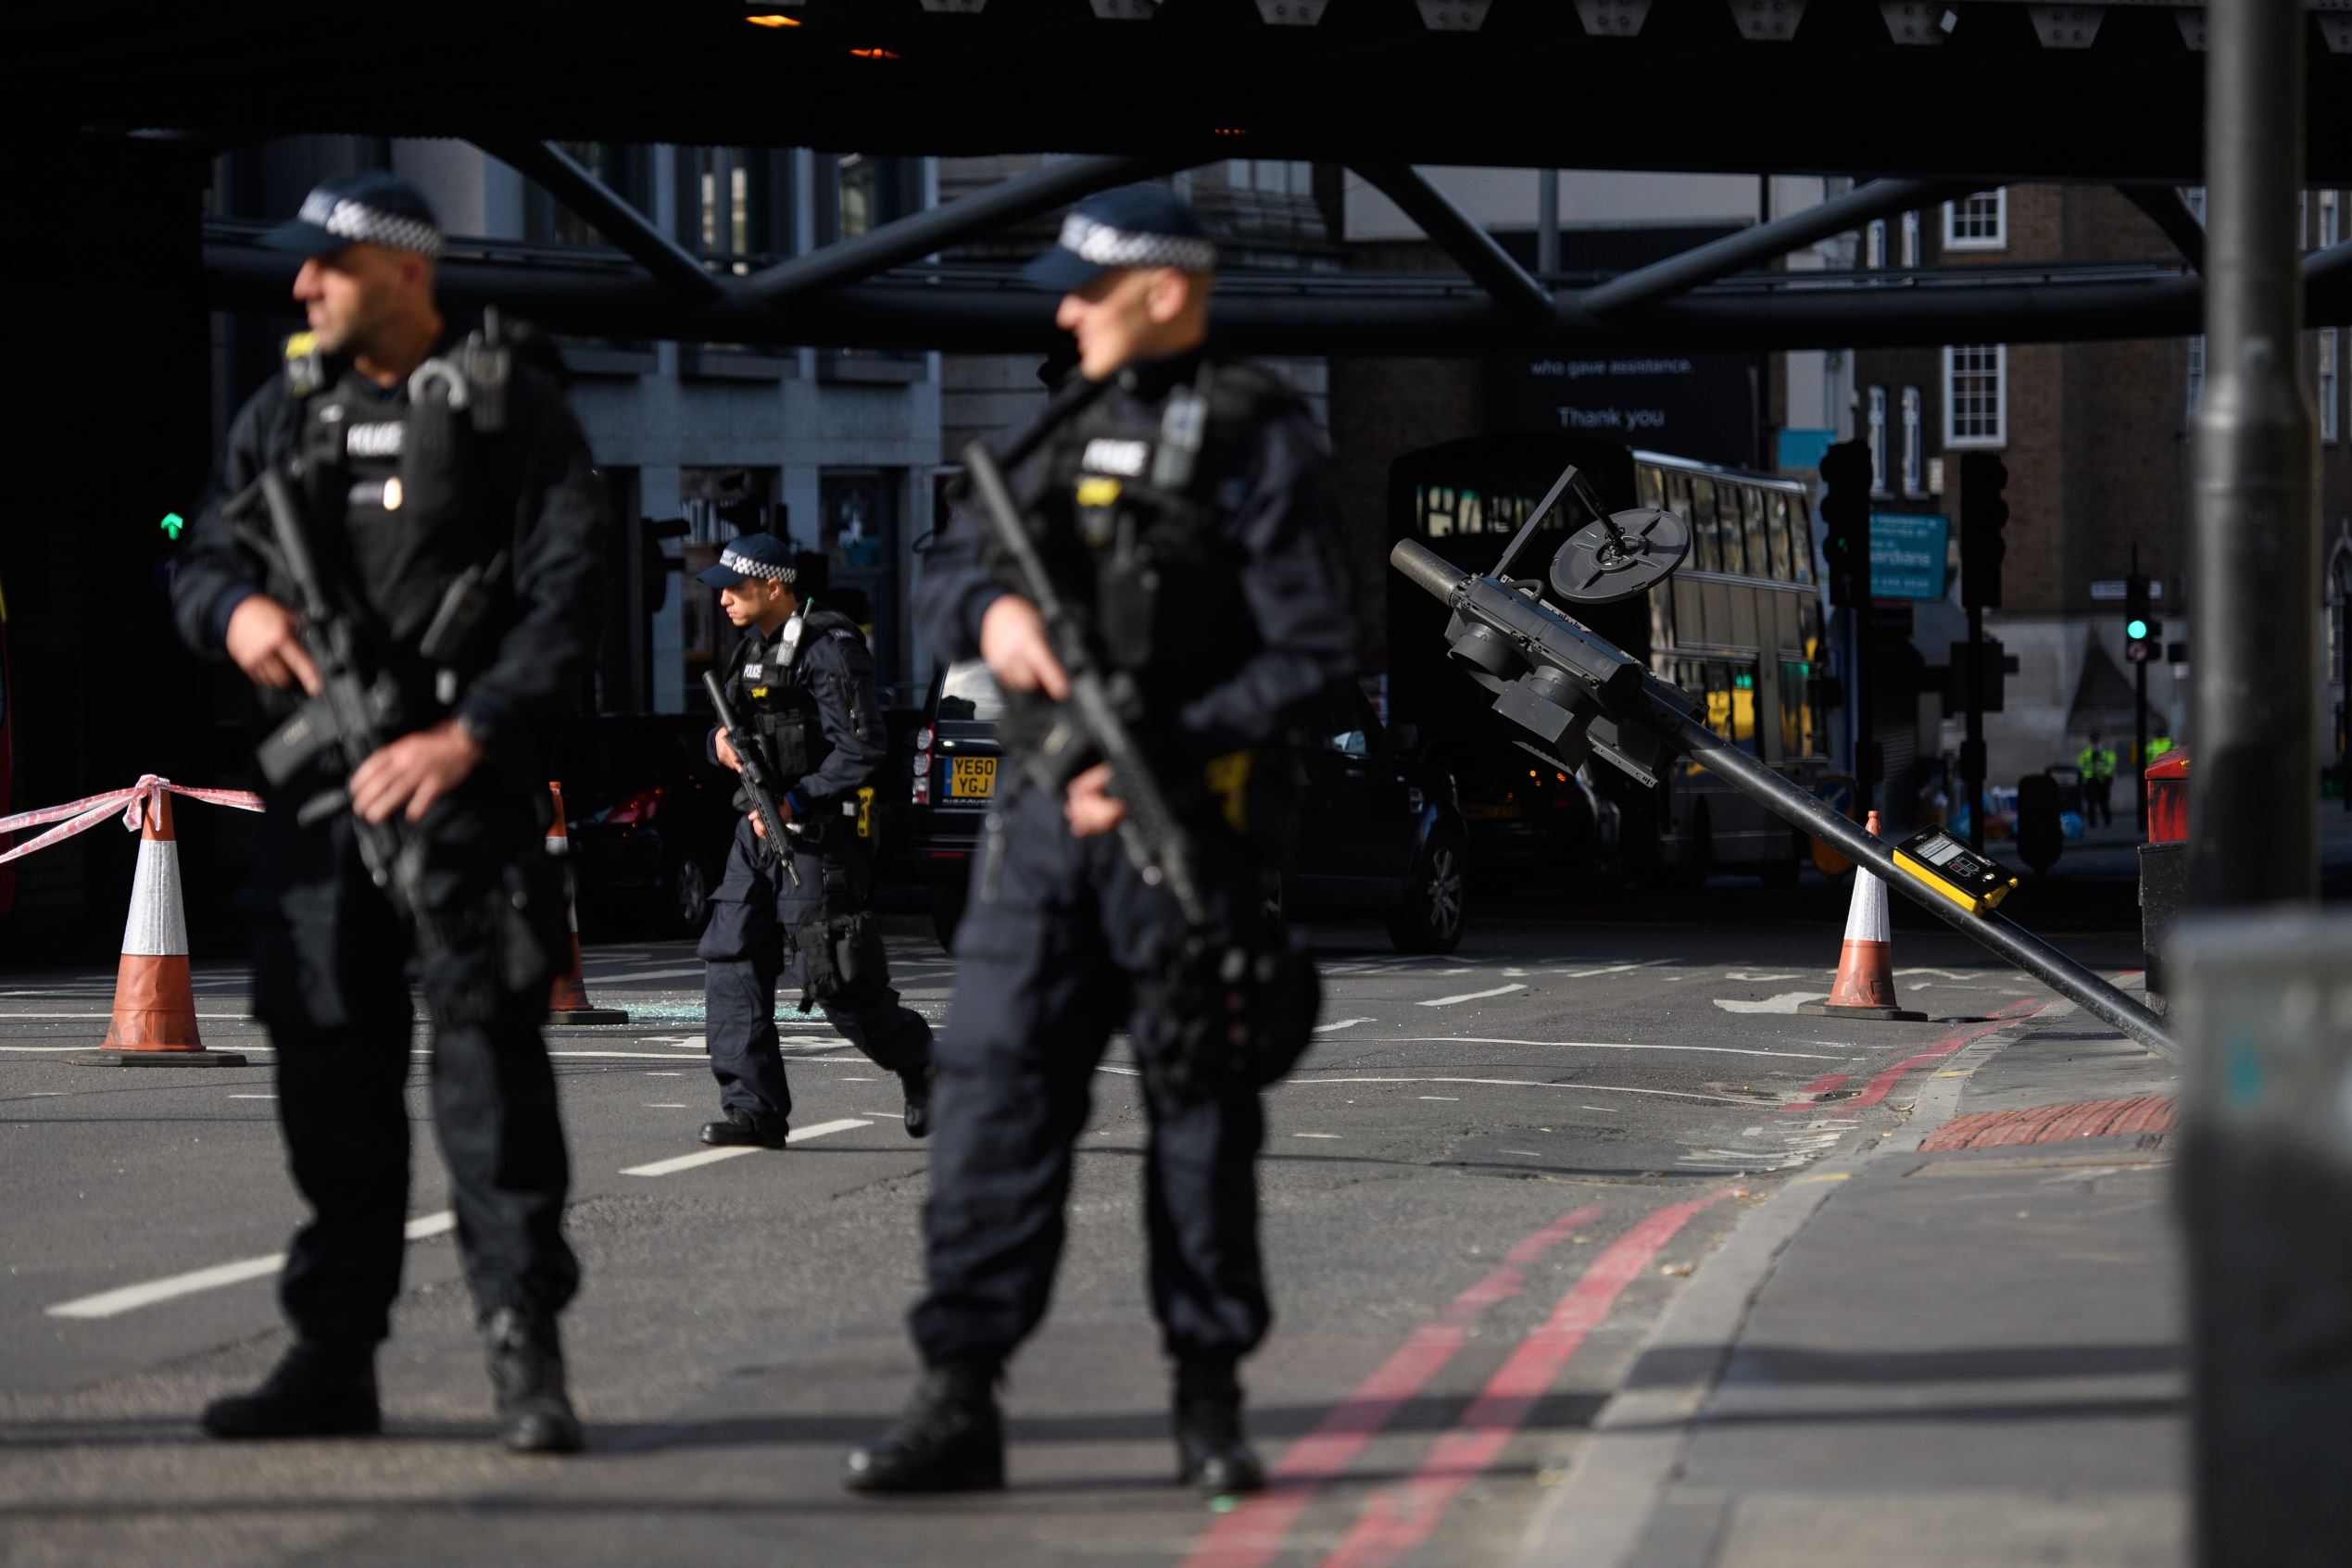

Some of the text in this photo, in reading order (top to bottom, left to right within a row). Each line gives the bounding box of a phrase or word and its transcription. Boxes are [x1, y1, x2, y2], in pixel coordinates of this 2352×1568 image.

[1530, 358, 1566, 375] who
[1567, 359, 1606, 379] gave
[1557, 407, 1666, 432] Thank you
[743, 663, 762, 678] POLICE
[954, 759, 994, 775] YE60
[959, 778, 989, 794] YGJ
